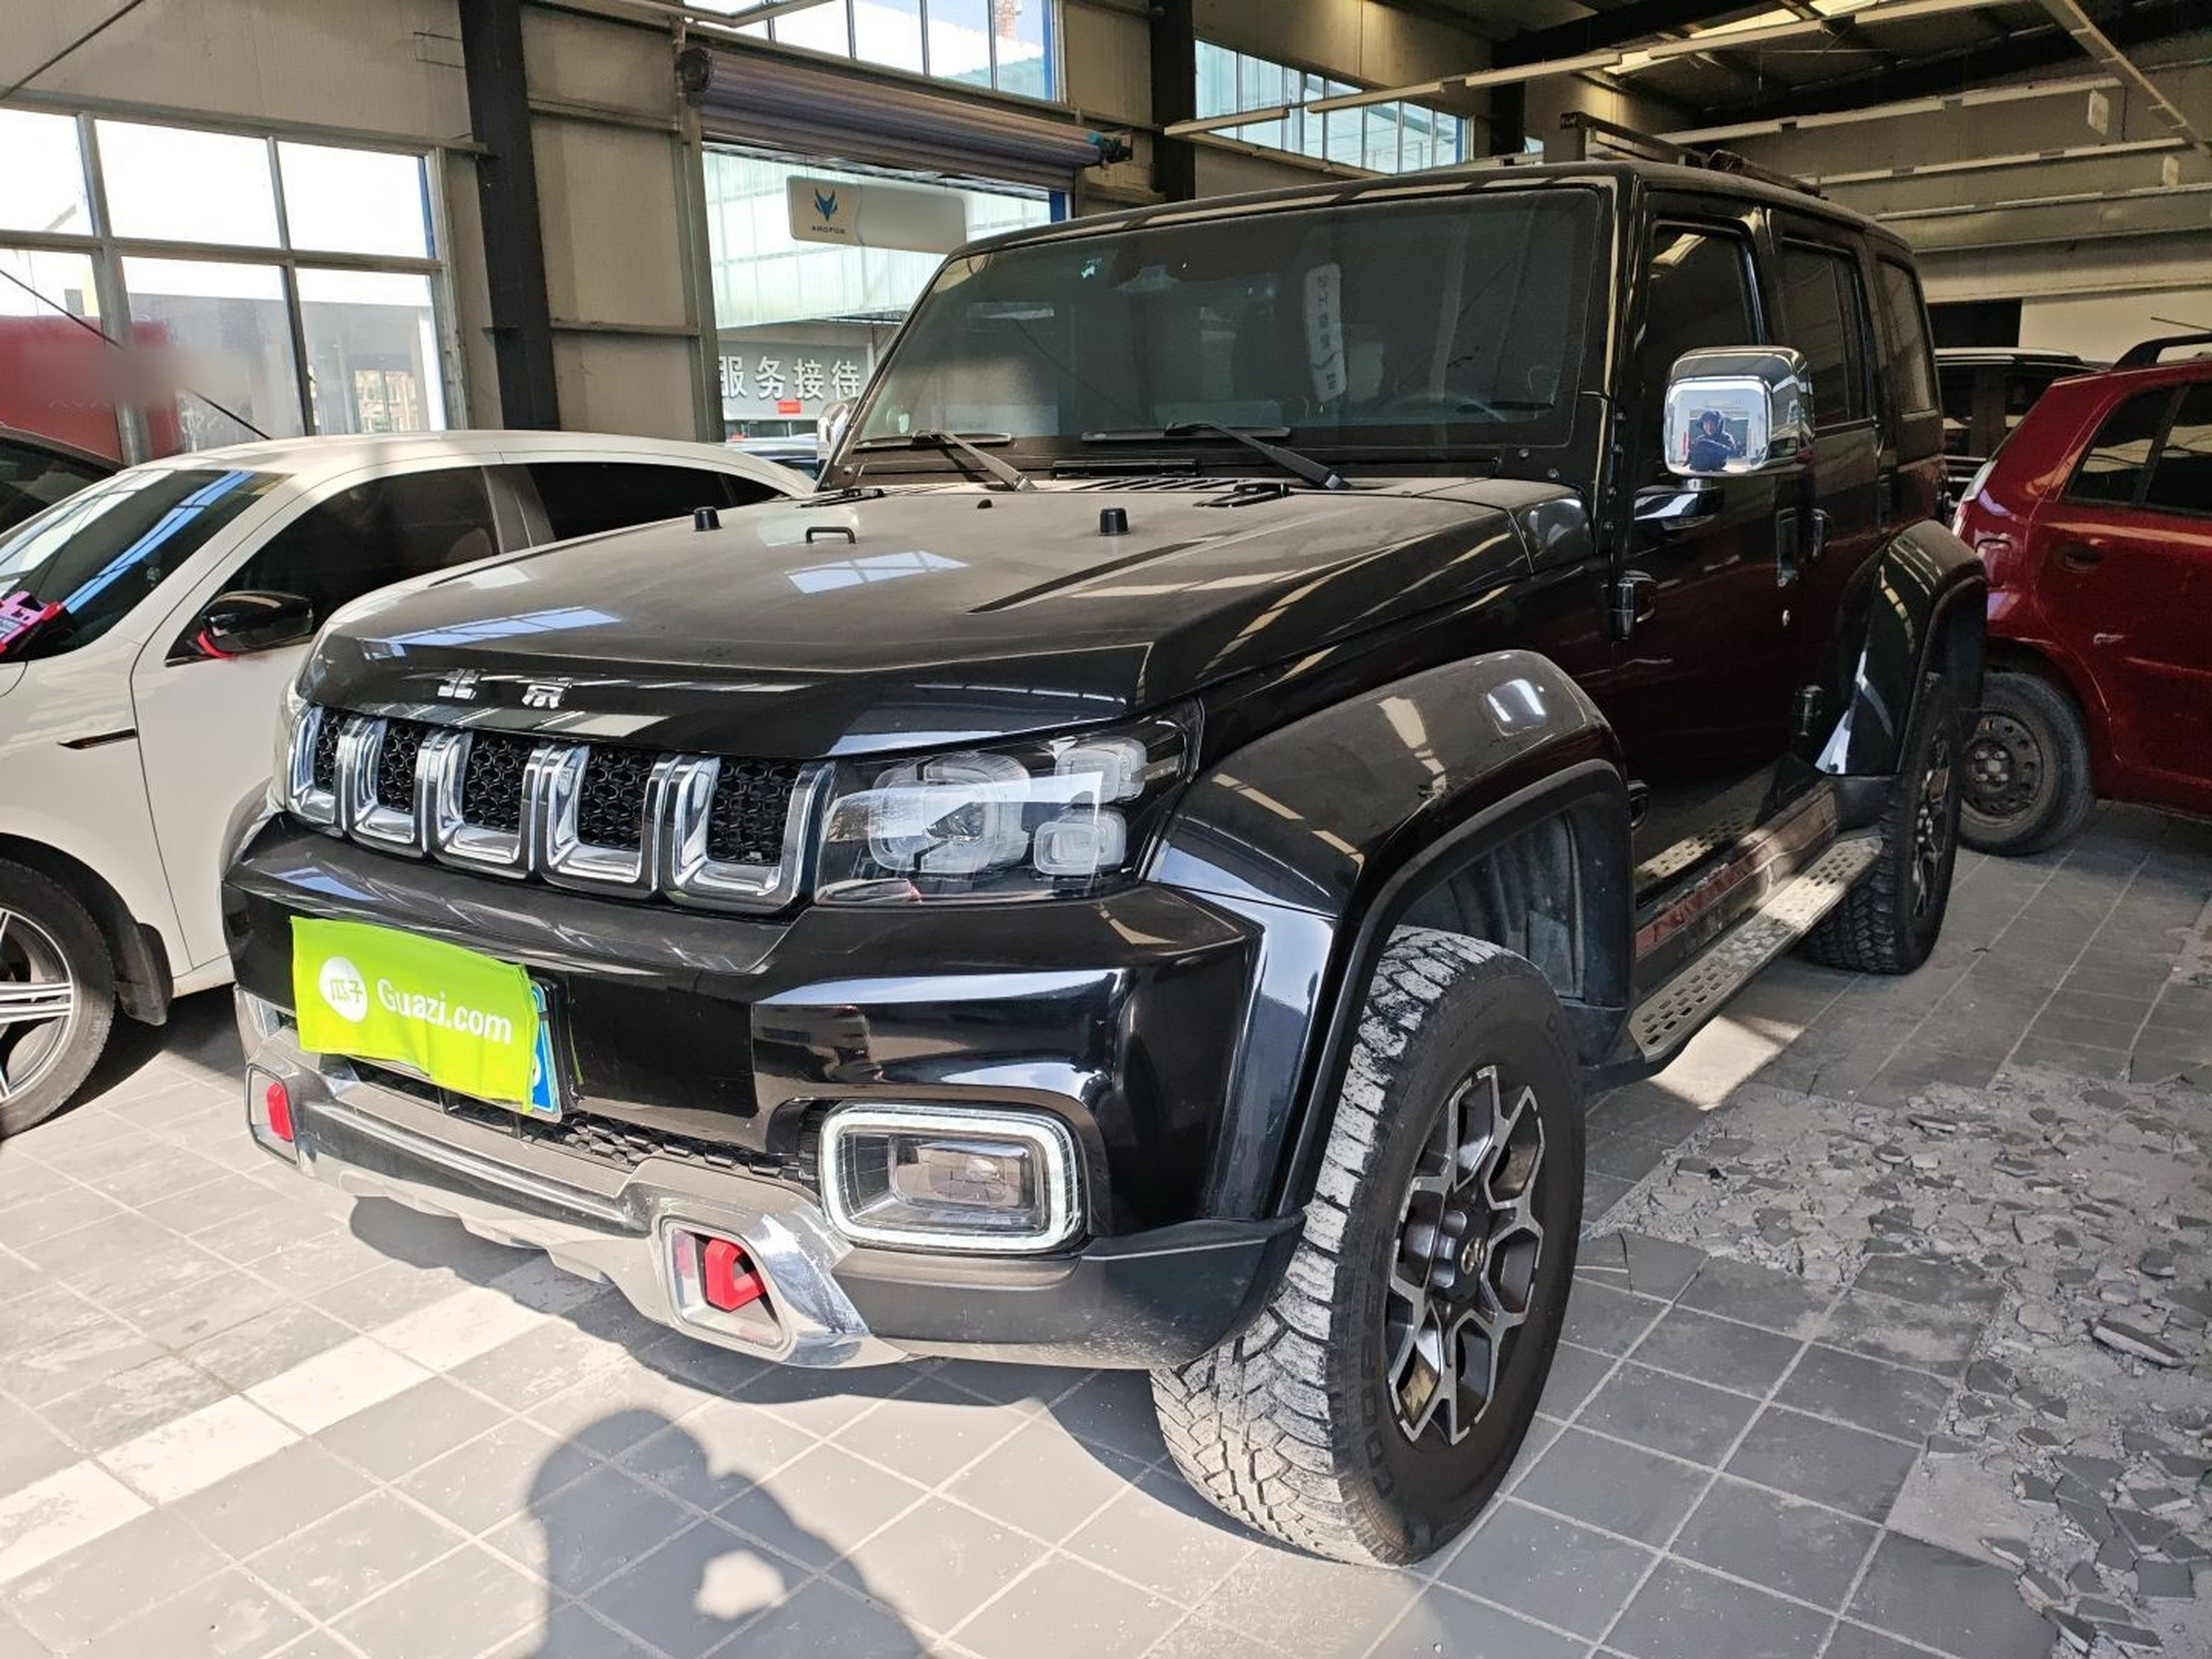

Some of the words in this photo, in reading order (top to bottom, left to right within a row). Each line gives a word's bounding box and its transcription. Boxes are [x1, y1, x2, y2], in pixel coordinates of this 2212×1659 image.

[719, 356, 860, 400] 服务接待
[377, 978, 512, 1045] Guazi.com
